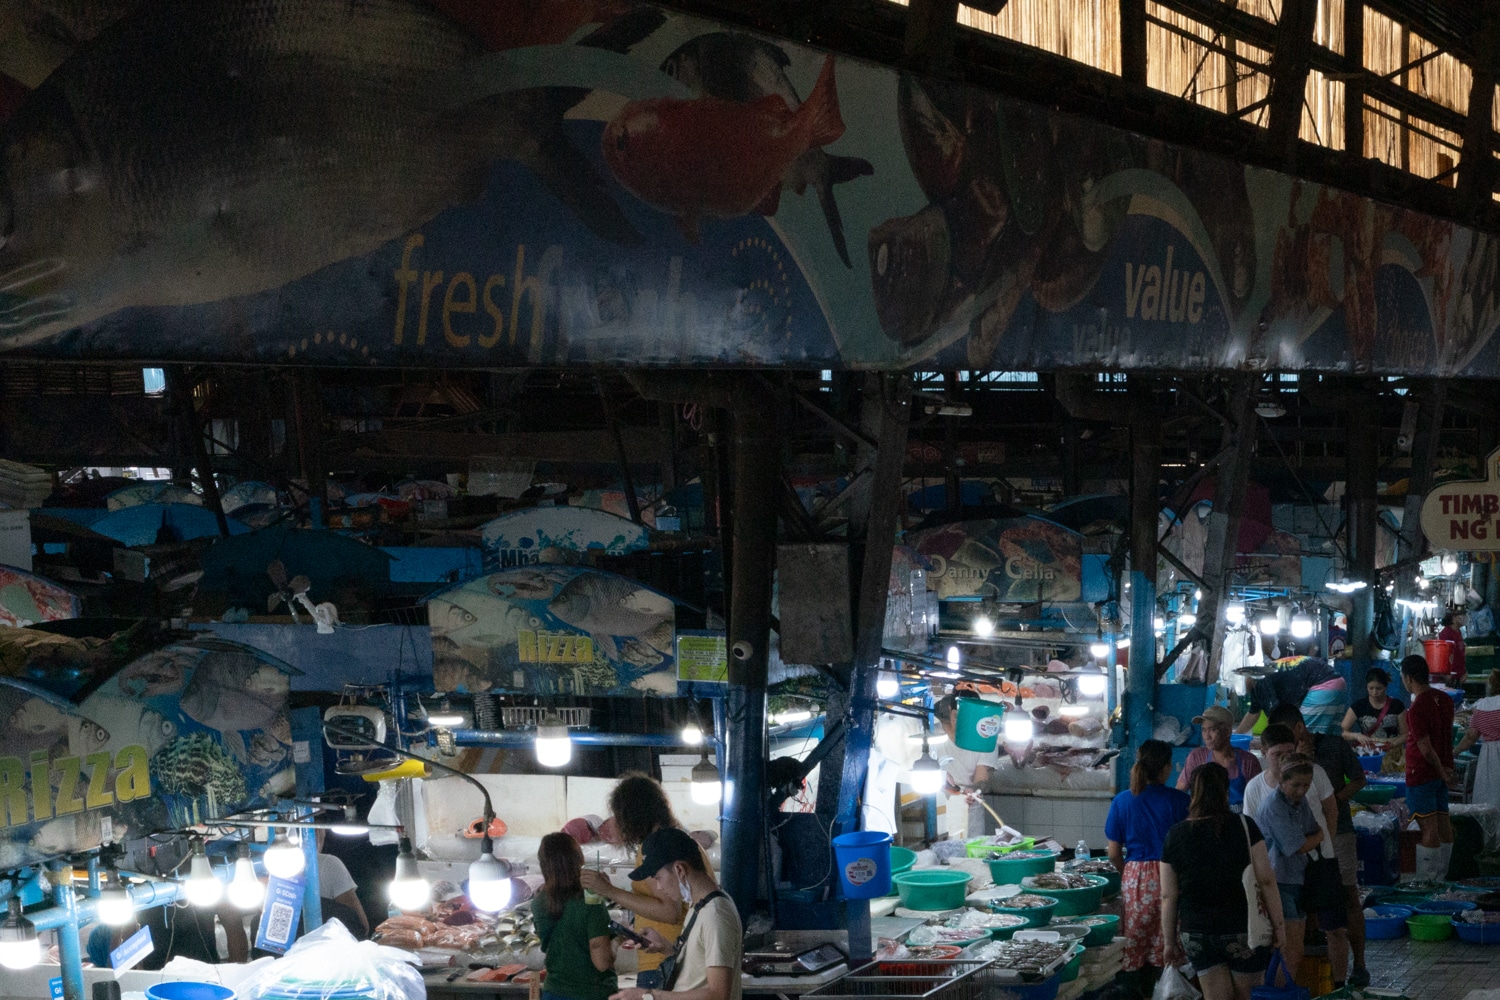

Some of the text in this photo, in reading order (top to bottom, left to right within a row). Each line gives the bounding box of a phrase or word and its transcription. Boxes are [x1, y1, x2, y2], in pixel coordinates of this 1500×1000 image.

[393, 233, 545, 348] fresh
[1125, 245, 1206, 324] value
[1450, 519, 1488, 540] NG
[930, 554, 991, 582] Danny
[1005, 557, 1055, 581] Celia
[518, 628, 594, 664] Rizza
[0, 744, 152, 829] Rizza
